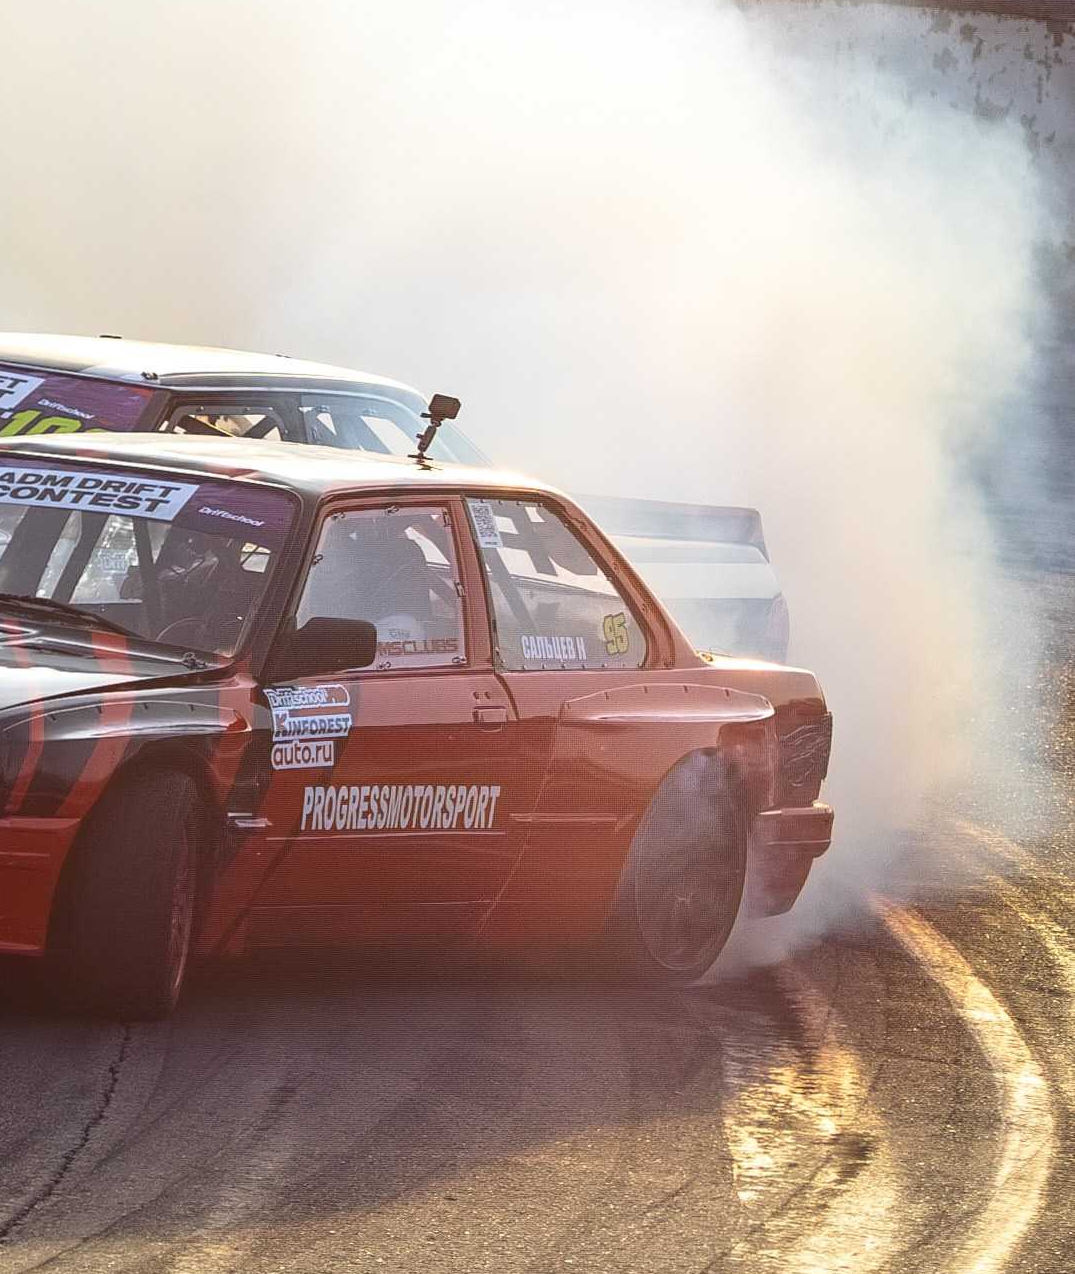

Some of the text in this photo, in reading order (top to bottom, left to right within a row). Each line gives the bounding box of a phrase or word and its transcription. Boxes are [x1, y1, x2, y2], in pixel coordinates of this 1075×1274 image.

[76, 477, 180, 498] DRIFT
[198, 506, 265, 527] Driftschool
[603, 612, 629, 655] 95
[521, 635, 576, 663] САЛЬЦЕВ
[268, 688, 329, 707] Driftschool
[274, 713, 350, 737] KINFOREST
[274, 743, 332, 766] auto.ru
[300, 785, 501, 830] PROGRESSMOTORSPORT
